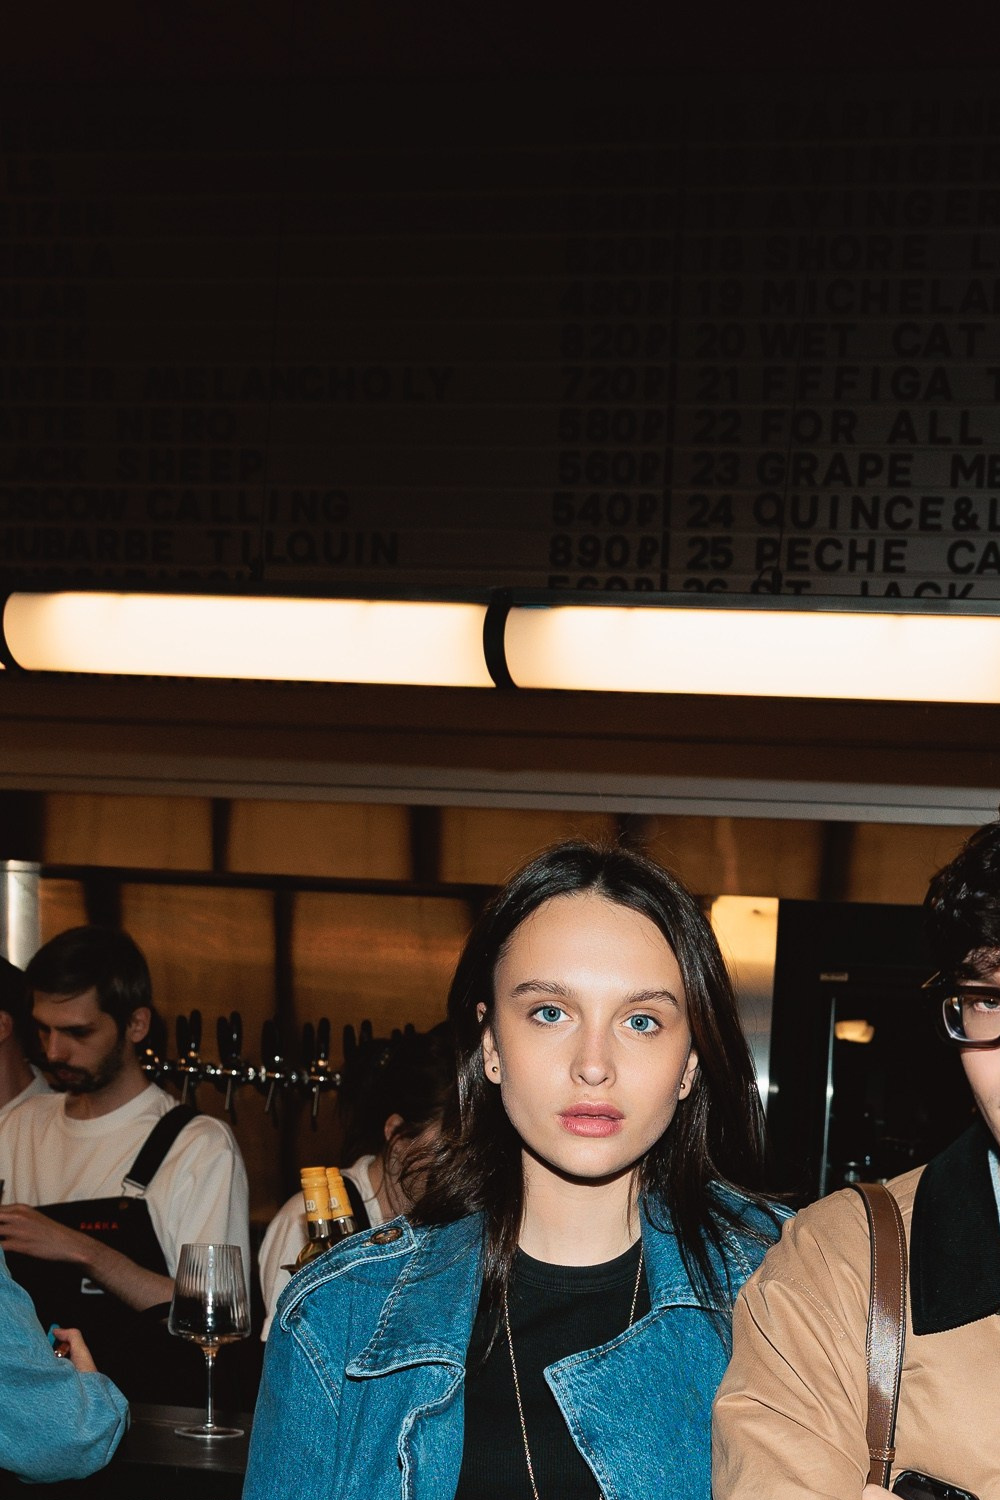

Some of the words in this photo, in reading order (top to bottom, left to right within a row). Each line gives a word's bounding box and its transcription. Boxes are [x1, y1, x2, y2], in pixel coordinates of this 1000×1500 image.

[700, 234, 745, 272] 18
[764, 234, 929, 272] SHORE
[698, 278, 744, 315] 19
[696, 321, 746, 359] 20
[758, 321, 857, 360] WET
[892, 322, 986, 359] CAT
[143, 365, 455, 401] MELANCHOLY
[697, 365, 739, 401] 21
[115, 407, 237, 442] NERO
[693, 409, 742, 444] 22
[760, 409, 859, 445] FOR
[887, 409, 984, 446] ALL
[115, 447, 264, 483] SHEEP
[691, 451, 740, 487] 23
[755, 451, 914, 488] GRAPE
[146, 488, 350, 524] CALLING
[685, 493, 735, 529] 24
[207, 529, 399, 566] TILQUIN
[685, 535, 735, 571] 25
[754, 536, 908, 574] PECHE
